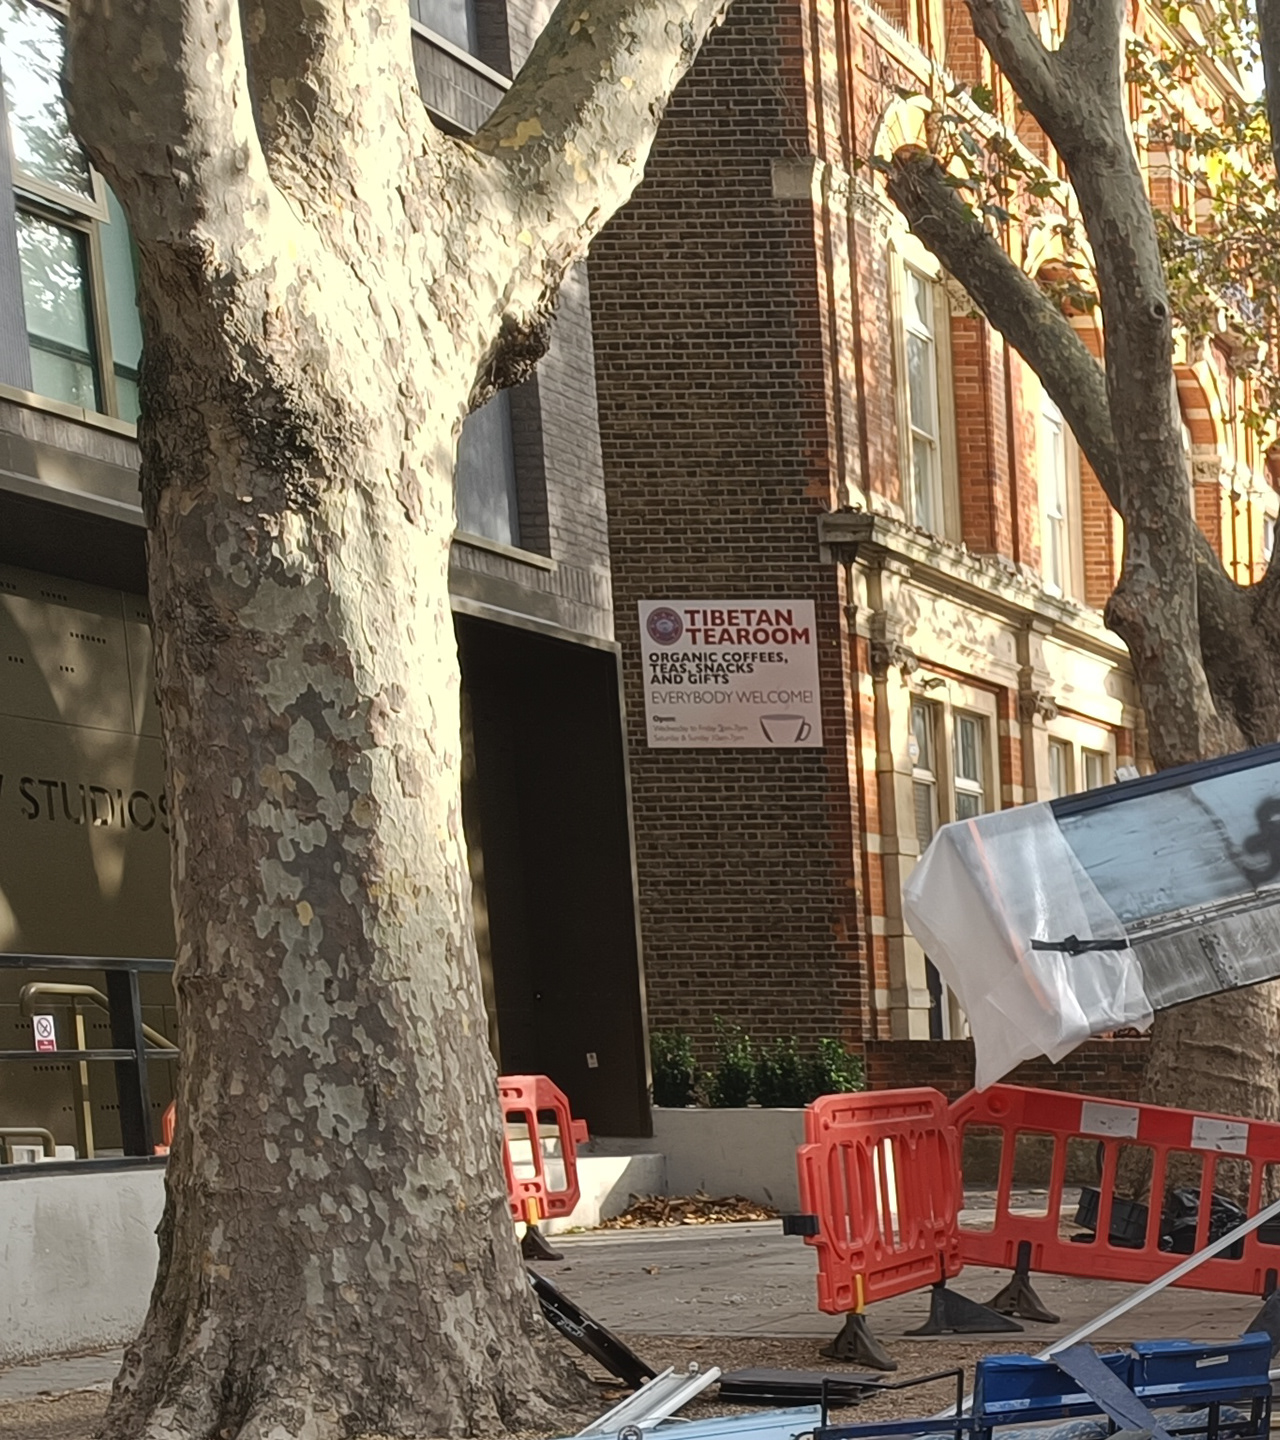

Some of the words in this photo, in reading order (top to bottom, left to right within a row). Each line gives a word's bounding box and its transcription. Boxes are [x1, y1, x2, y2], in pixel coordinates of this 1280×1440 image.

[684, 609, 793, 627] TIBETAN
[685, 628, 811, 646] TEAROOM
[649, 652, 717, 663] ORGANIC
[721, 651, 789, 664] COFFEES,
[650, 663, 692, 675] TEAS,
[696, 662, 755, 674] SNACKS
[651, 674, 683, 685] AND
[688, 673, 730, 685] GIFTS
[651, 690, 733, 705] EVERYBODY
[738, 690, 813, 705] WELCOME!
